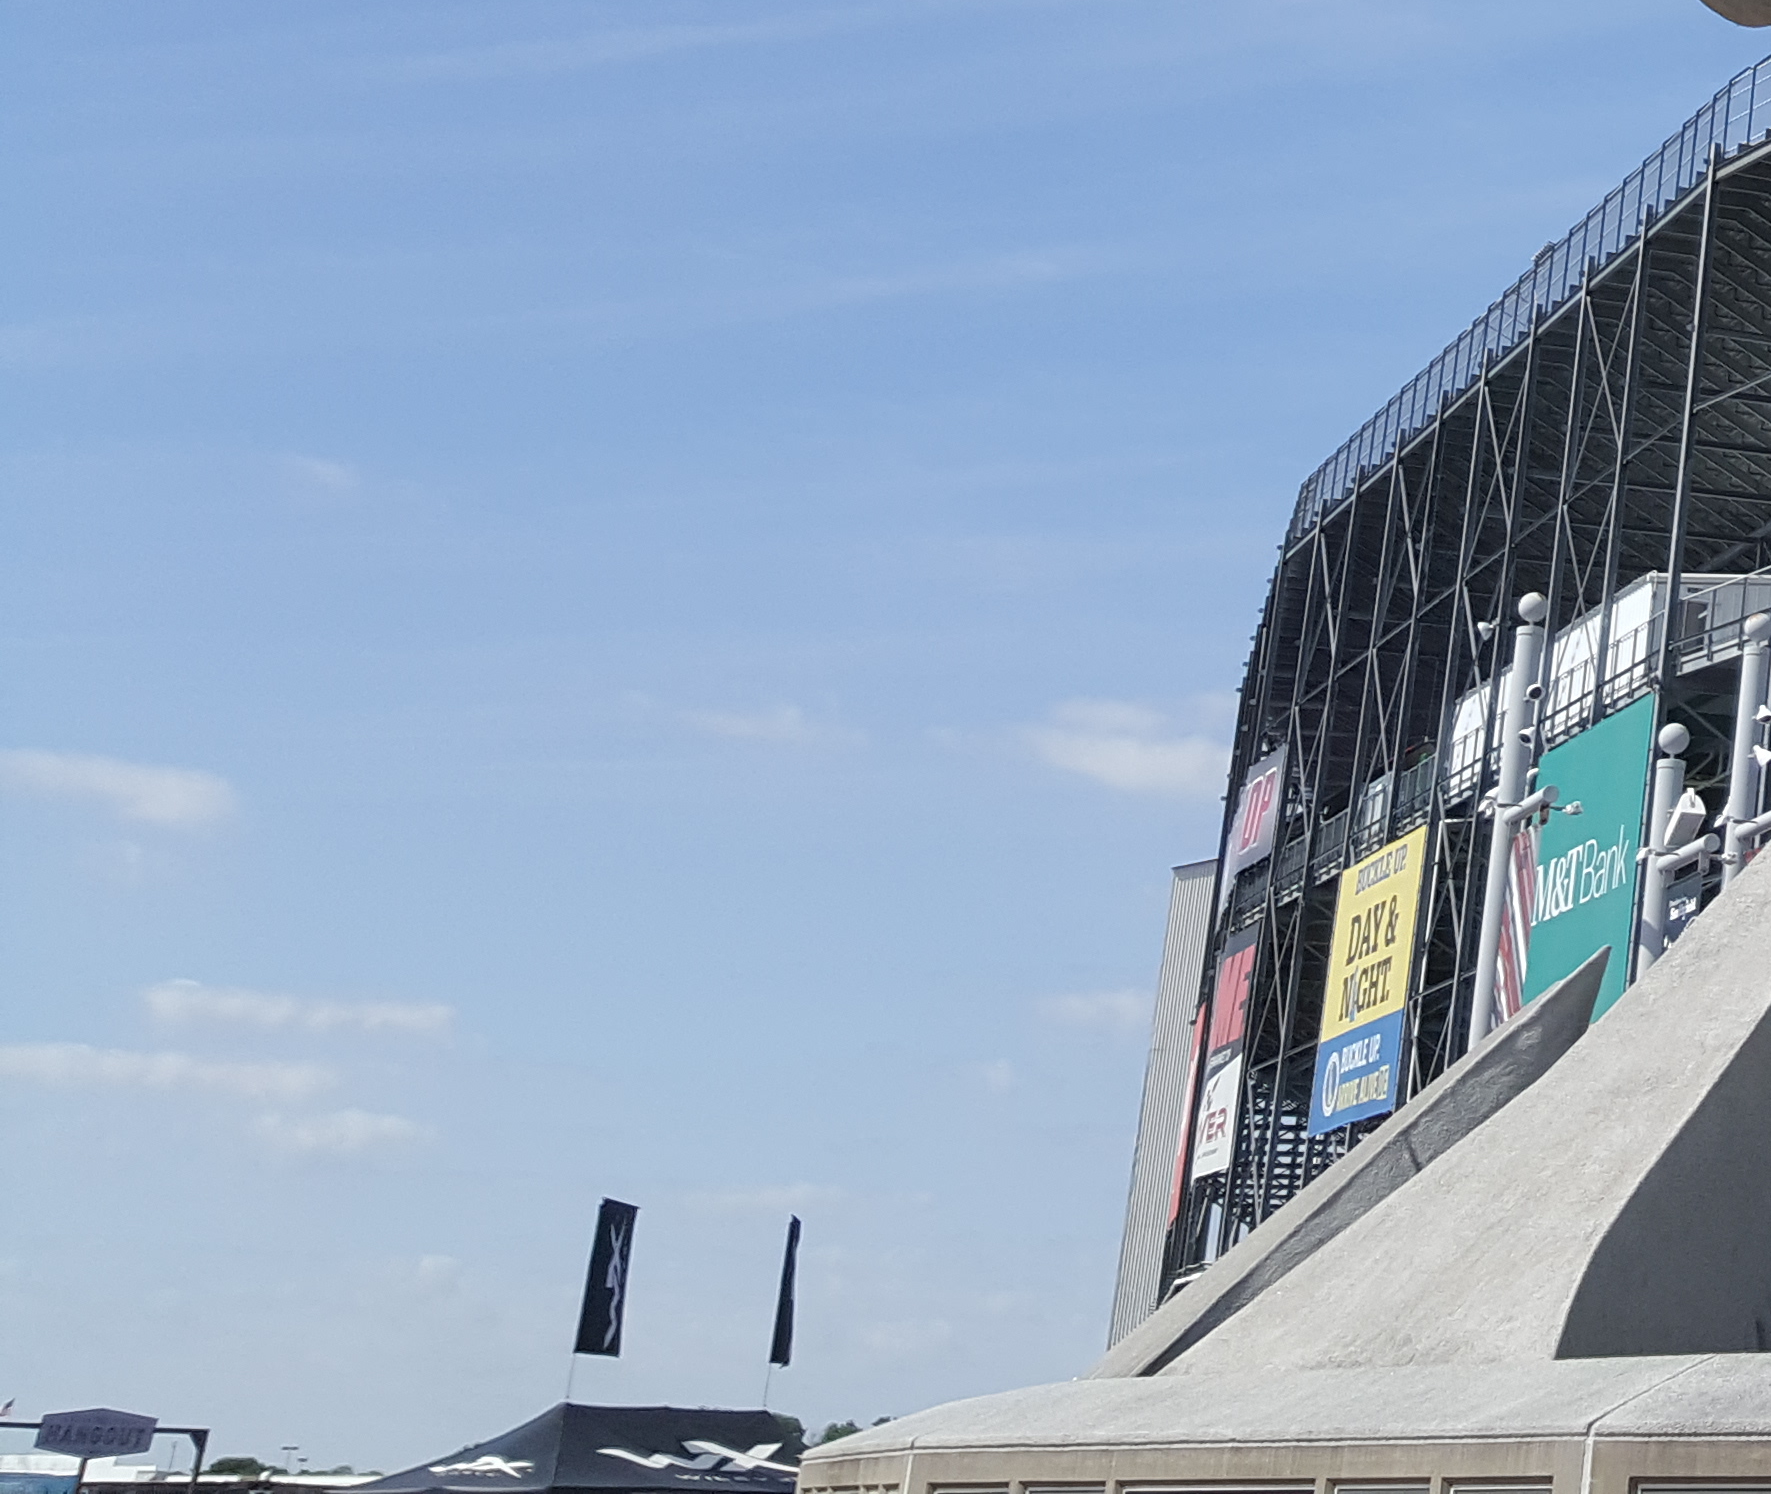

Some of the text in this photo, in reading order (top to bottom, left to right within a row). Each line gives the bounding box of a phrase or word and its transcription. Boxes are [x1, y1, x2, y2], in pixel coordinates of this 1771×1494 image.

[1531, 824, 1629, 926] M&T Bank
[1345, 894, 1399, 966] DAY &
